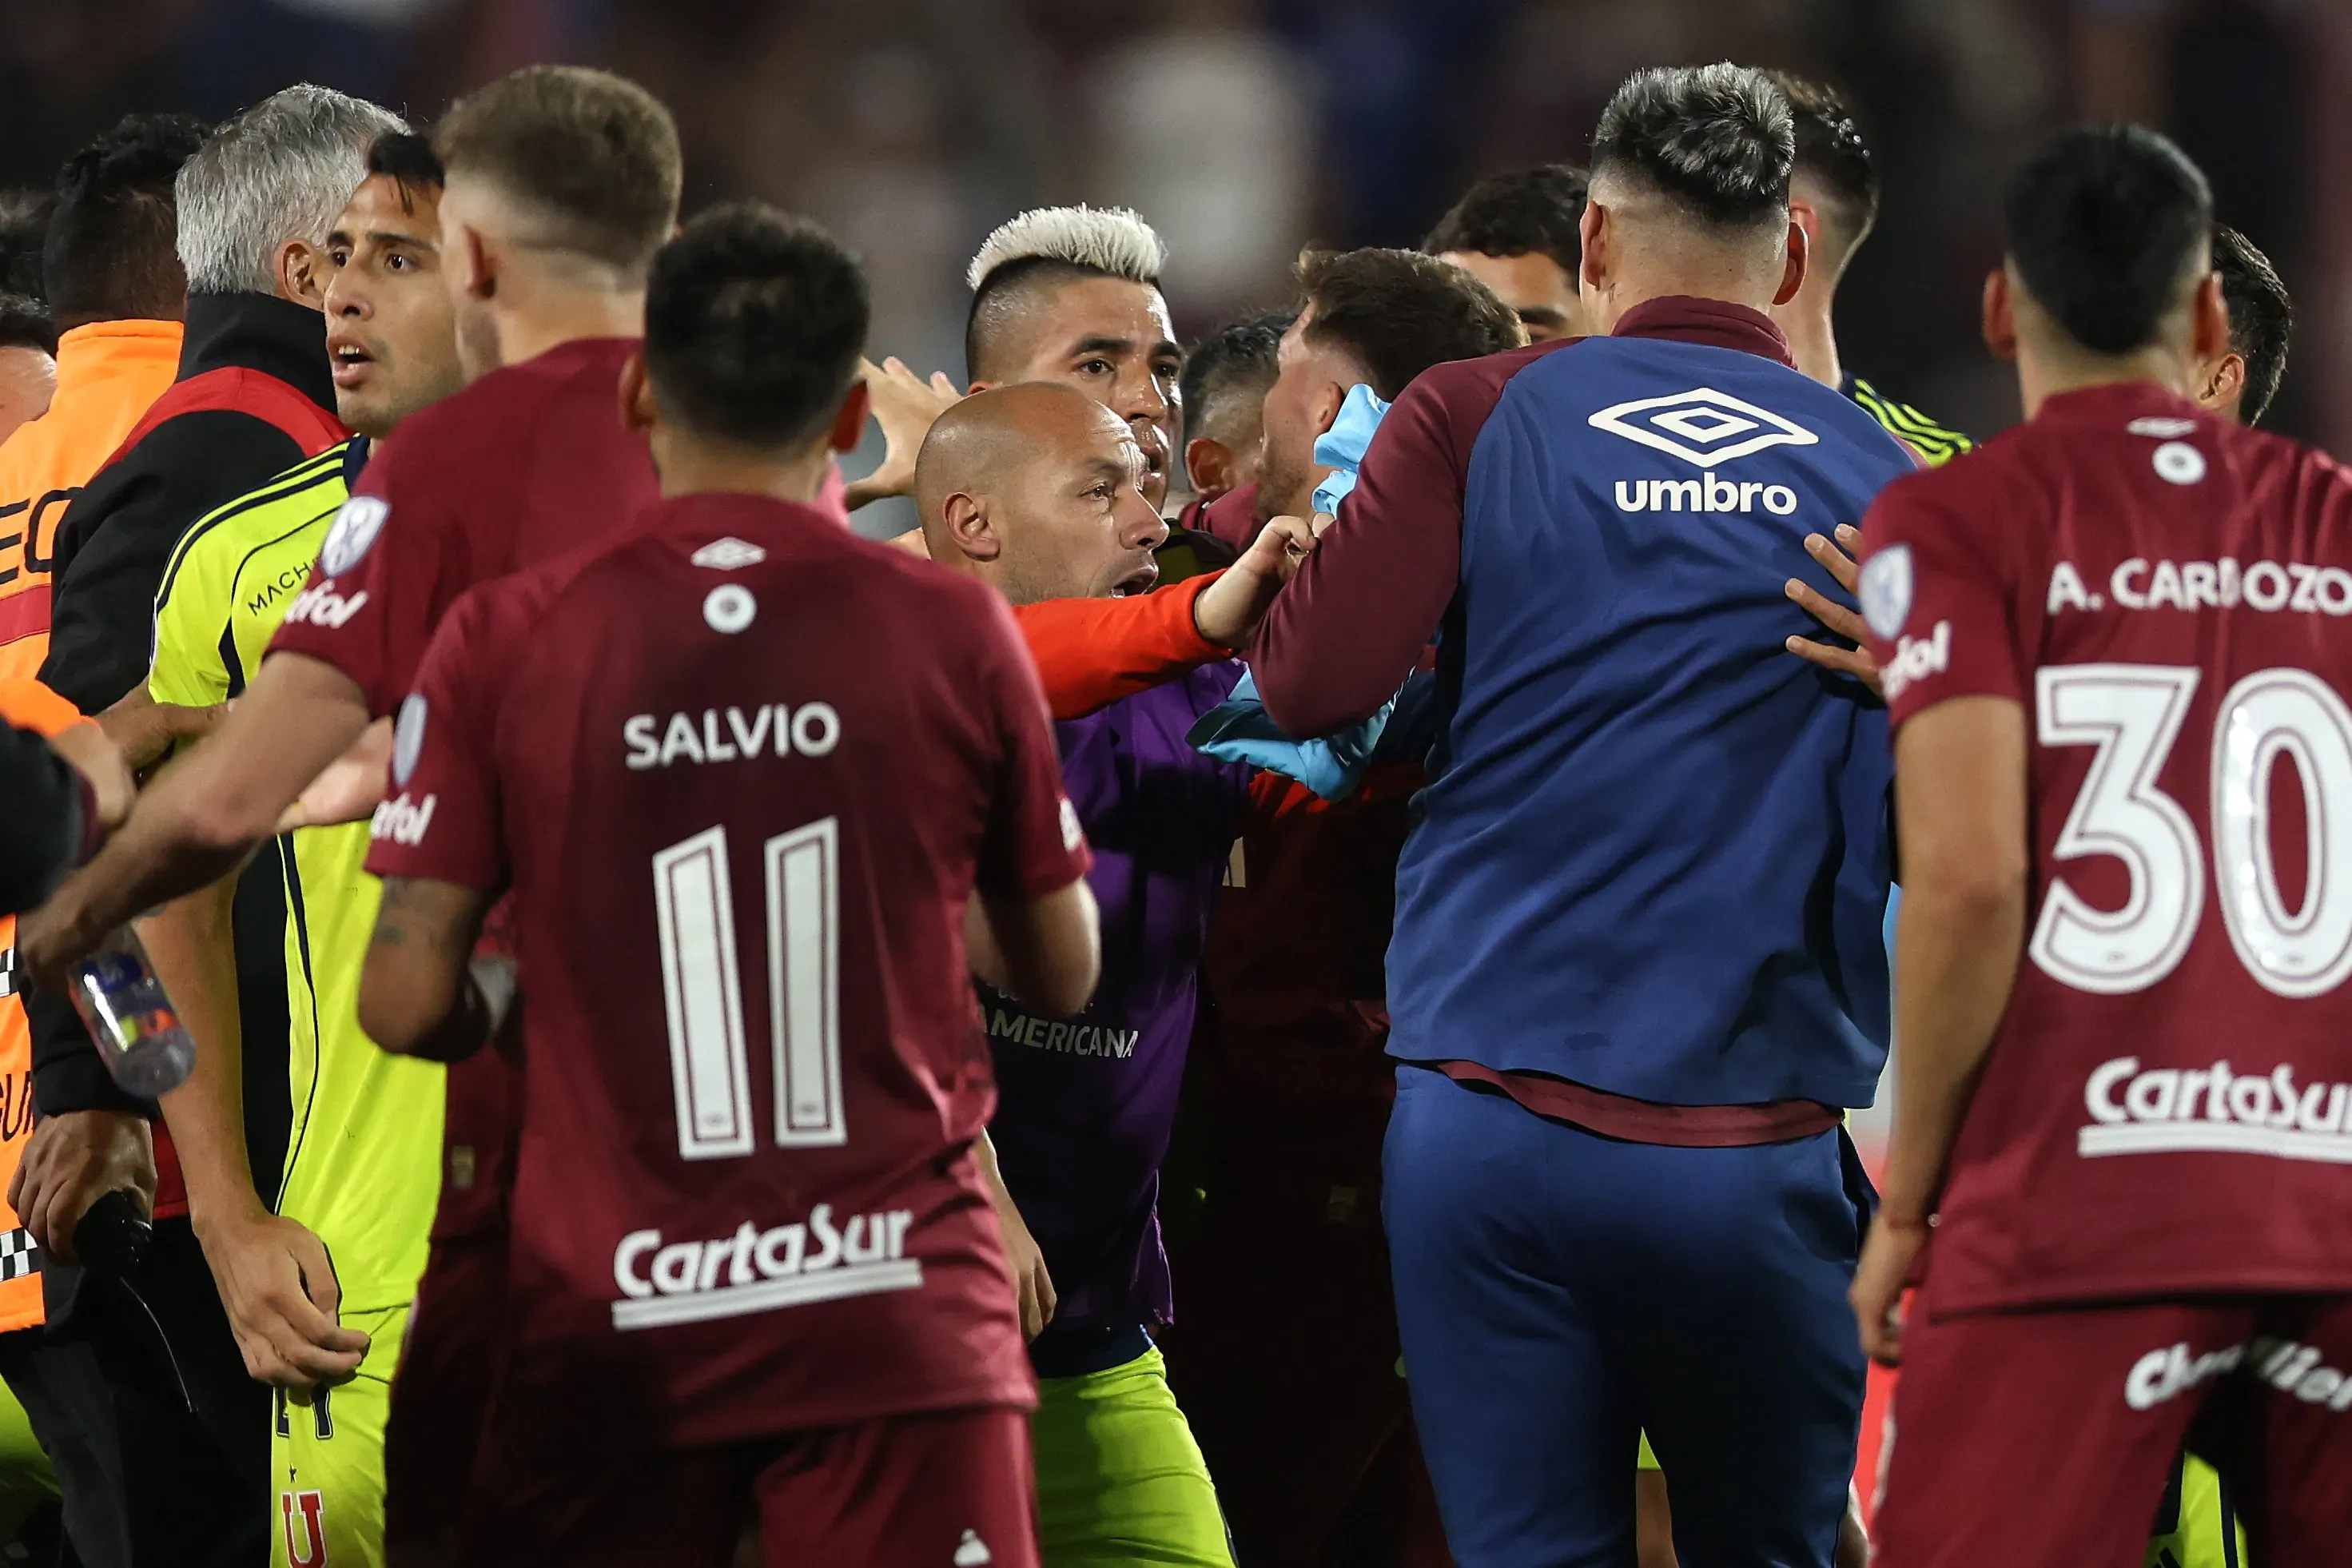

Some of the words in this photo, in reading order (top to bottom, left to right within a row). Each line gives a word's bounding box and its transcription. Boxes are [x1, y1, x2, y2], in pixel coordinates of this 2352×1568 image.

[1614, 472, 1797, 515] umbro
[248, 557, 319, 617] MACH
[2047, 560, 2104, 615] A.
[623, 701, 840, 770] SALVIO
[2028, 663, 2352, 999] 30
[652, 814, 847, 1160] 11
[980, 1005, 1139, 1058] MERICANA
[613, 1203, 913, 1299] CartaSur
